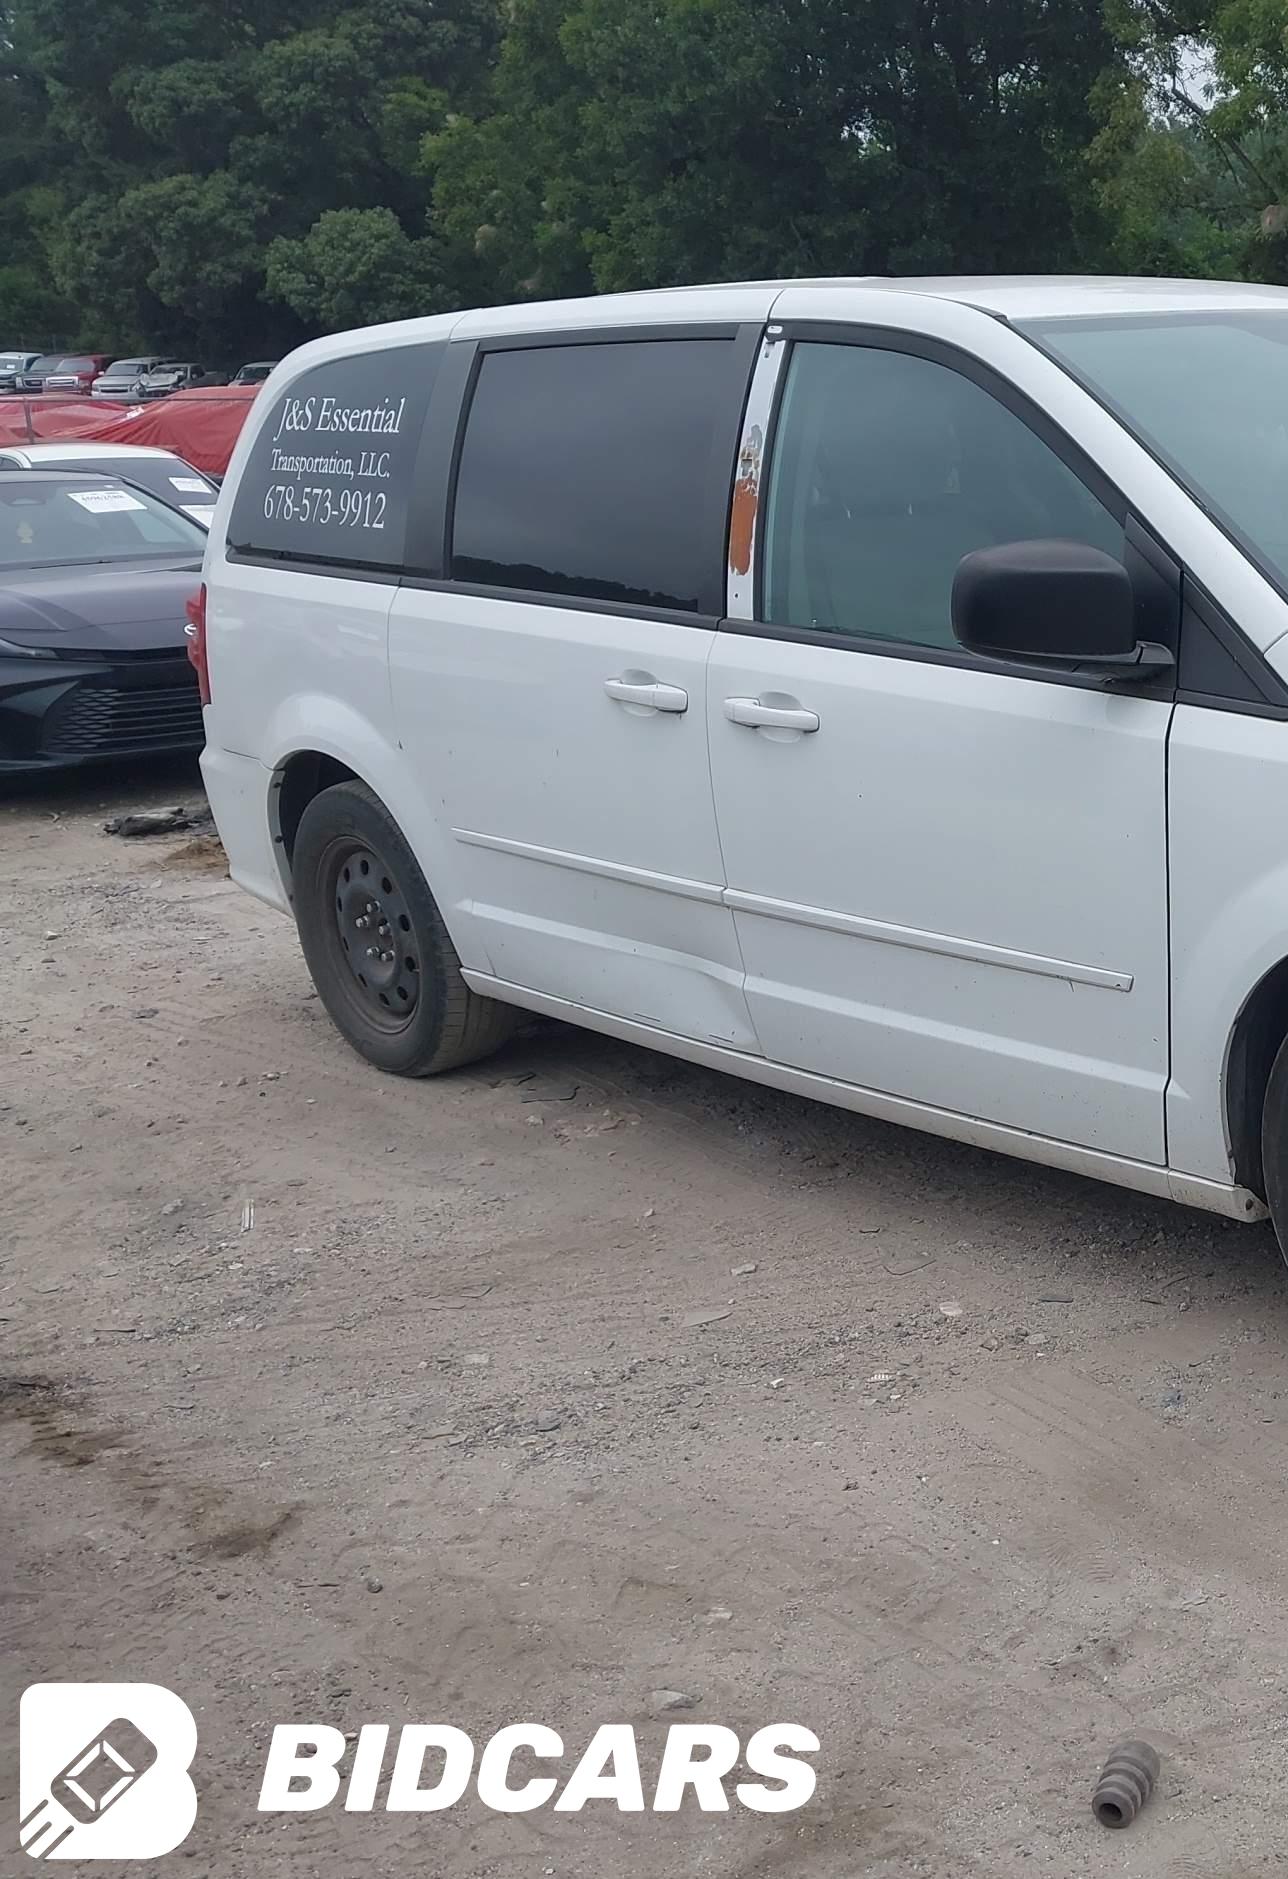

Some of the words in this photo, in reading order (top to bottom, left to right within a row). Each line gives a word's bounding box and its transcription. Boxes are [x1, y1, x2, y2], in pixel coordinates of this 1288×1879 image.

[273, 397, 315, 441] J&S
[315, 397, 406, 434] Essential
[271, 448, 355, 480] Transportation,
[358, 451, 391, 479] LLC.
[264, 484, 387, 529] 678-573-9912
